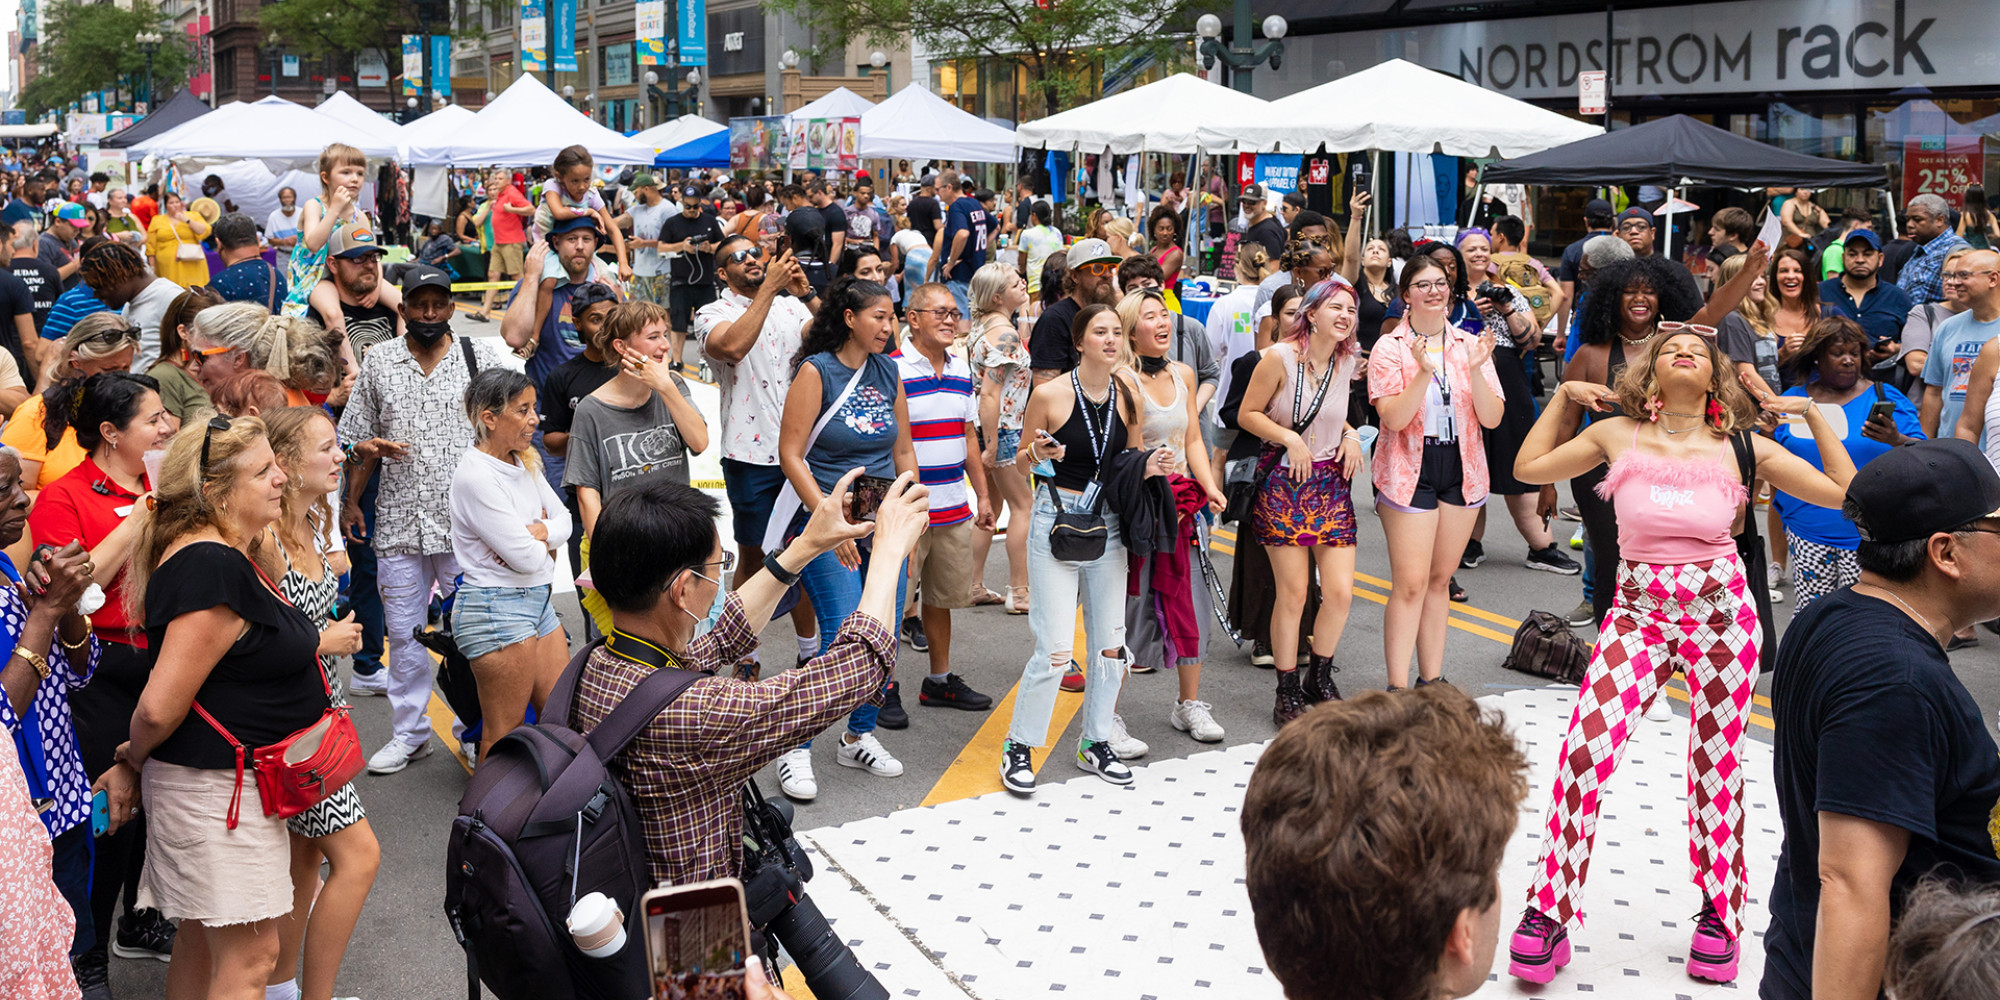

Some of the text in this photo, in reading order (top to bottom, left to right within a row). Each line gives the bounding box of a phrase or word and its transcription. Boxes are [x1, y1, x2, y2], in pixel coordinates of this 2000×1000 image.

[639, 19, 661, 31] STATE
[1459, 0, 1937, 90] NORDSTROM rack
[975, 224, 987, 252] 78
[1091, 437, 1099, 457] SCHOOL
[697, 481, 726, 489] AUTION
